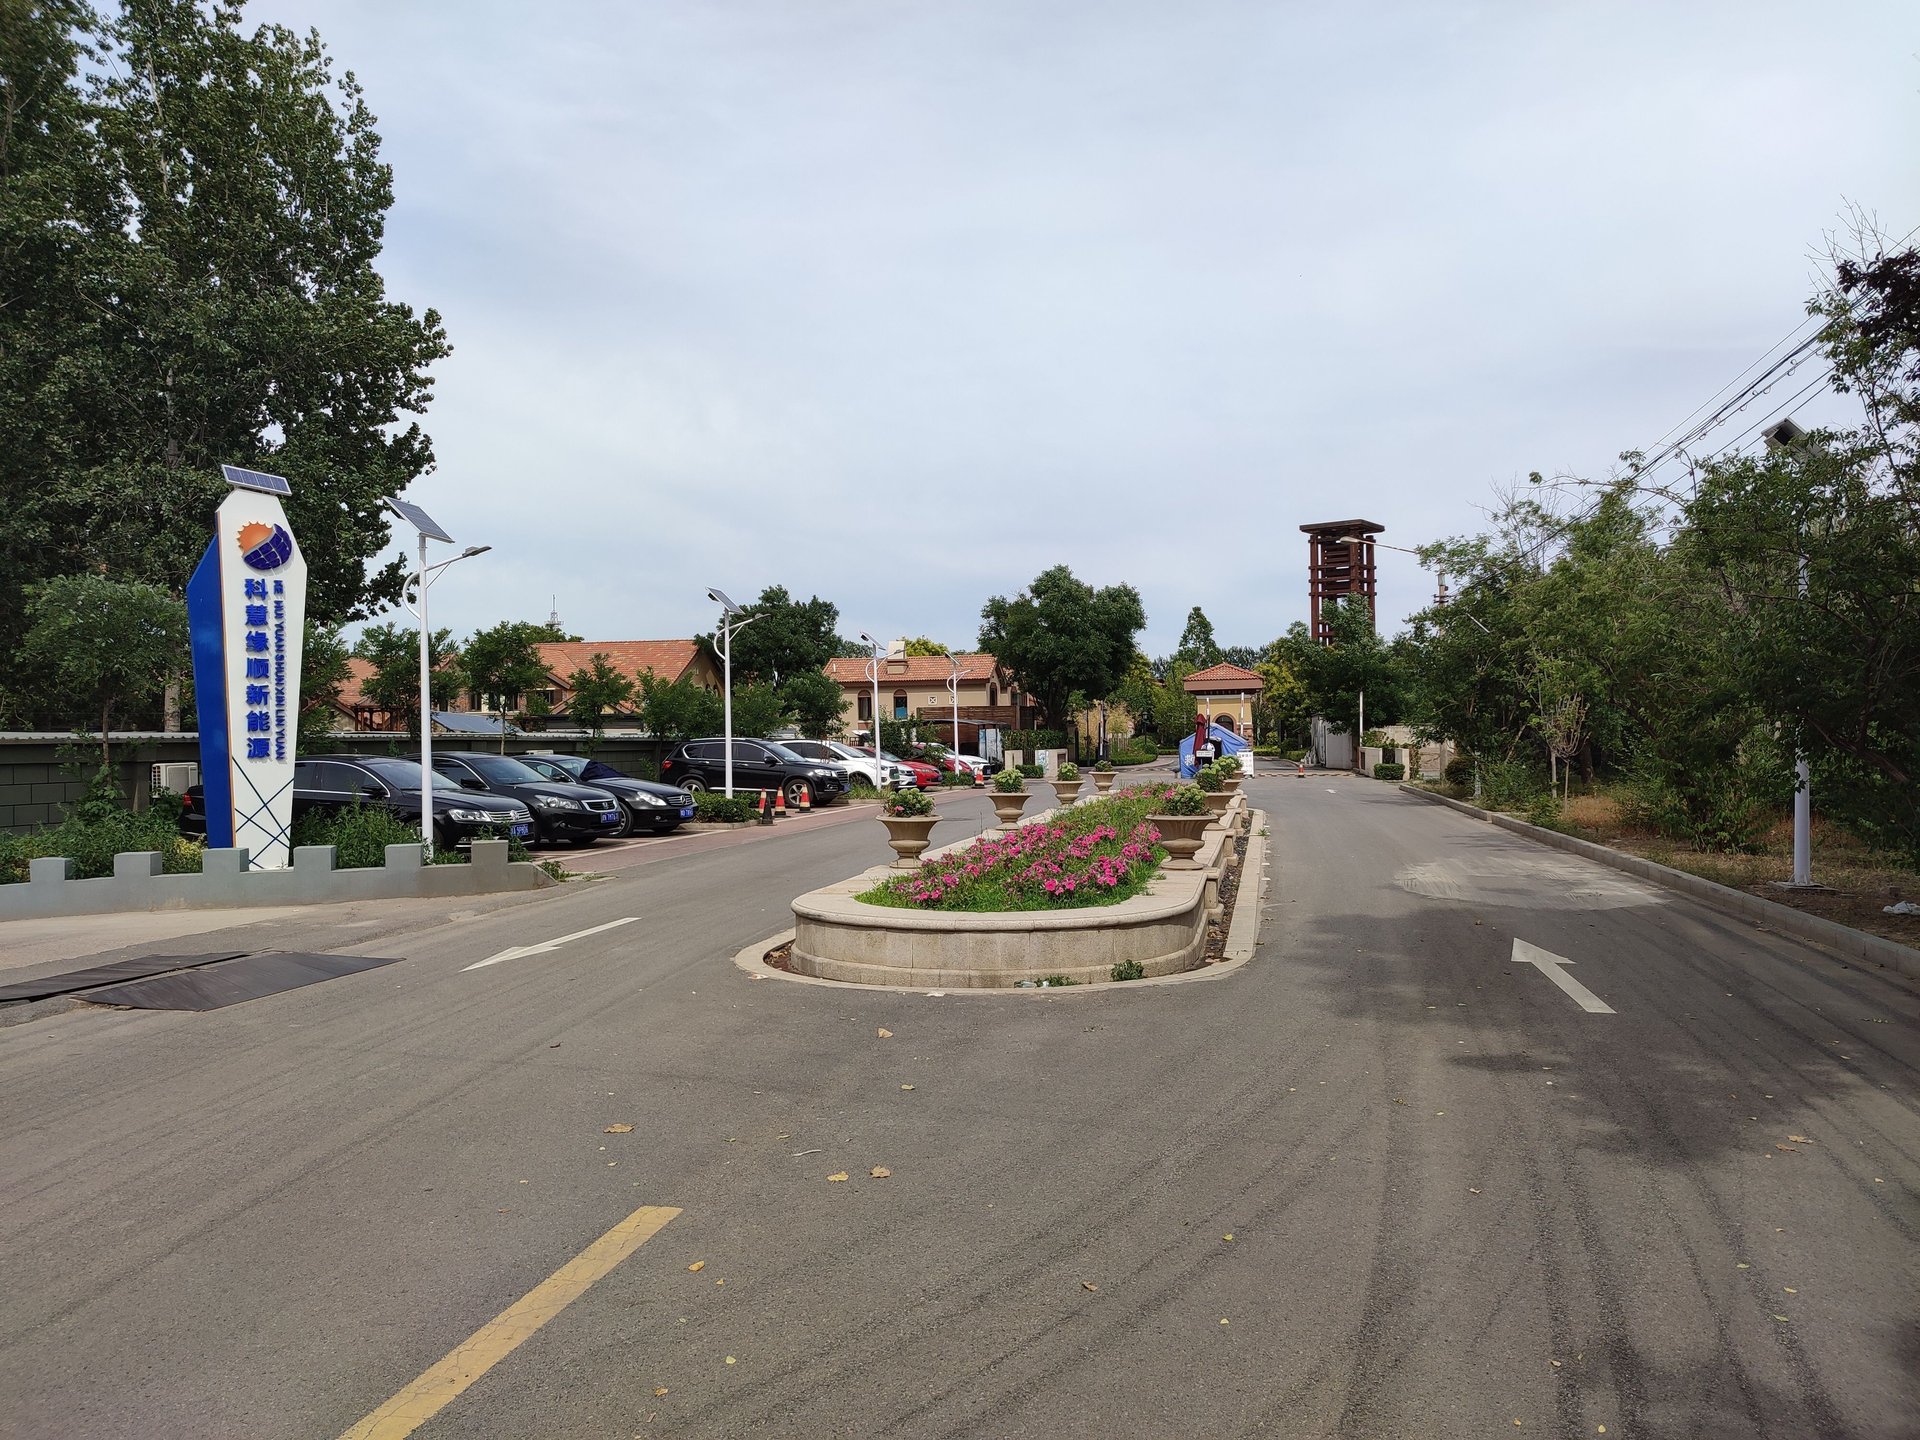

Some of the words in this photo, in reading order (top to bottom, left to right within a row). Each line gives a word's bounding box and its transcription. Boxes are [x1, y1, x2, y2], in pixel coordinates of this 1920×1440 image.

[273, 579, 284, 595] KE
[273, 600, 284, 619] HUI
[274, 621, 285, 653] YUAN
[244, 578, 271, 758] 科慧缘顺新能源
[274, 653, 285, 687] SHUN
[274, 687, 286, 707] XIN
[275, 728, 286, 760] YUAN
